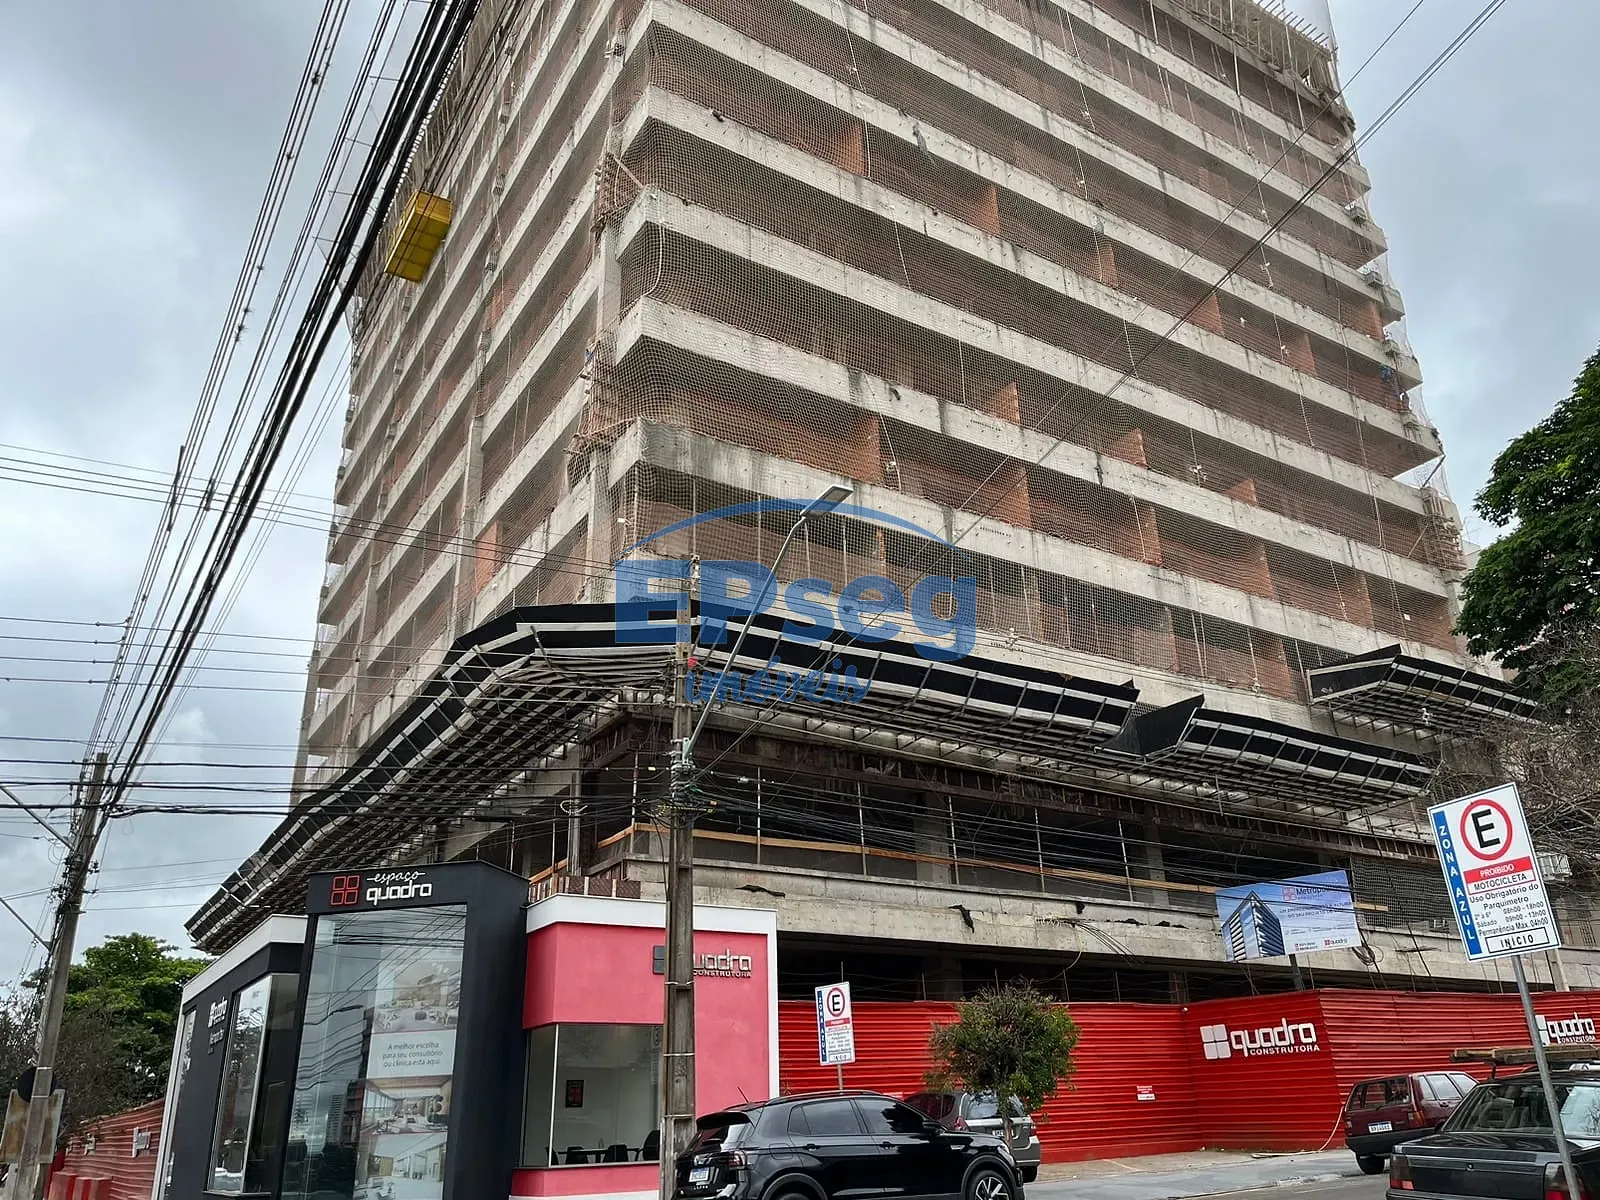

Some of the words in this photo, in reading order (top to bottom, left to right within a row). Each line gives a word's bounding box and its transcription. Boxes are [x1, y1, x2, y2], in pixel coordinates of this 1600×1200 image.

[1471, 808, 1501, 848] E
[366, 871, 426, 885] espaço
[1479, 863, 1515, 877] PROIBIDO
[366, 880, 433, 905] quadra
[1438, 825, 1460, 877] ZONA
[1455, 887, 1475, 940] AZUL
[1474, 873, 1527, 890] MOTOCICLETA
[1469, 894, 1484, 904] Uso
[1485, 885, 1527, 899] Obrigatório
[1528, 882, 1539, 892] do
[1500, 934, 1534, 948] INÍCIO
[692, 948, 752, 970] uadra
[832, 994, 841, 1012] E
[1230, 1017, 1317, 1057] quadra
[1546, 1011, 1596, 1044] quadra
[1249, 1044, 1320, 1056] CONSTRUTORA
